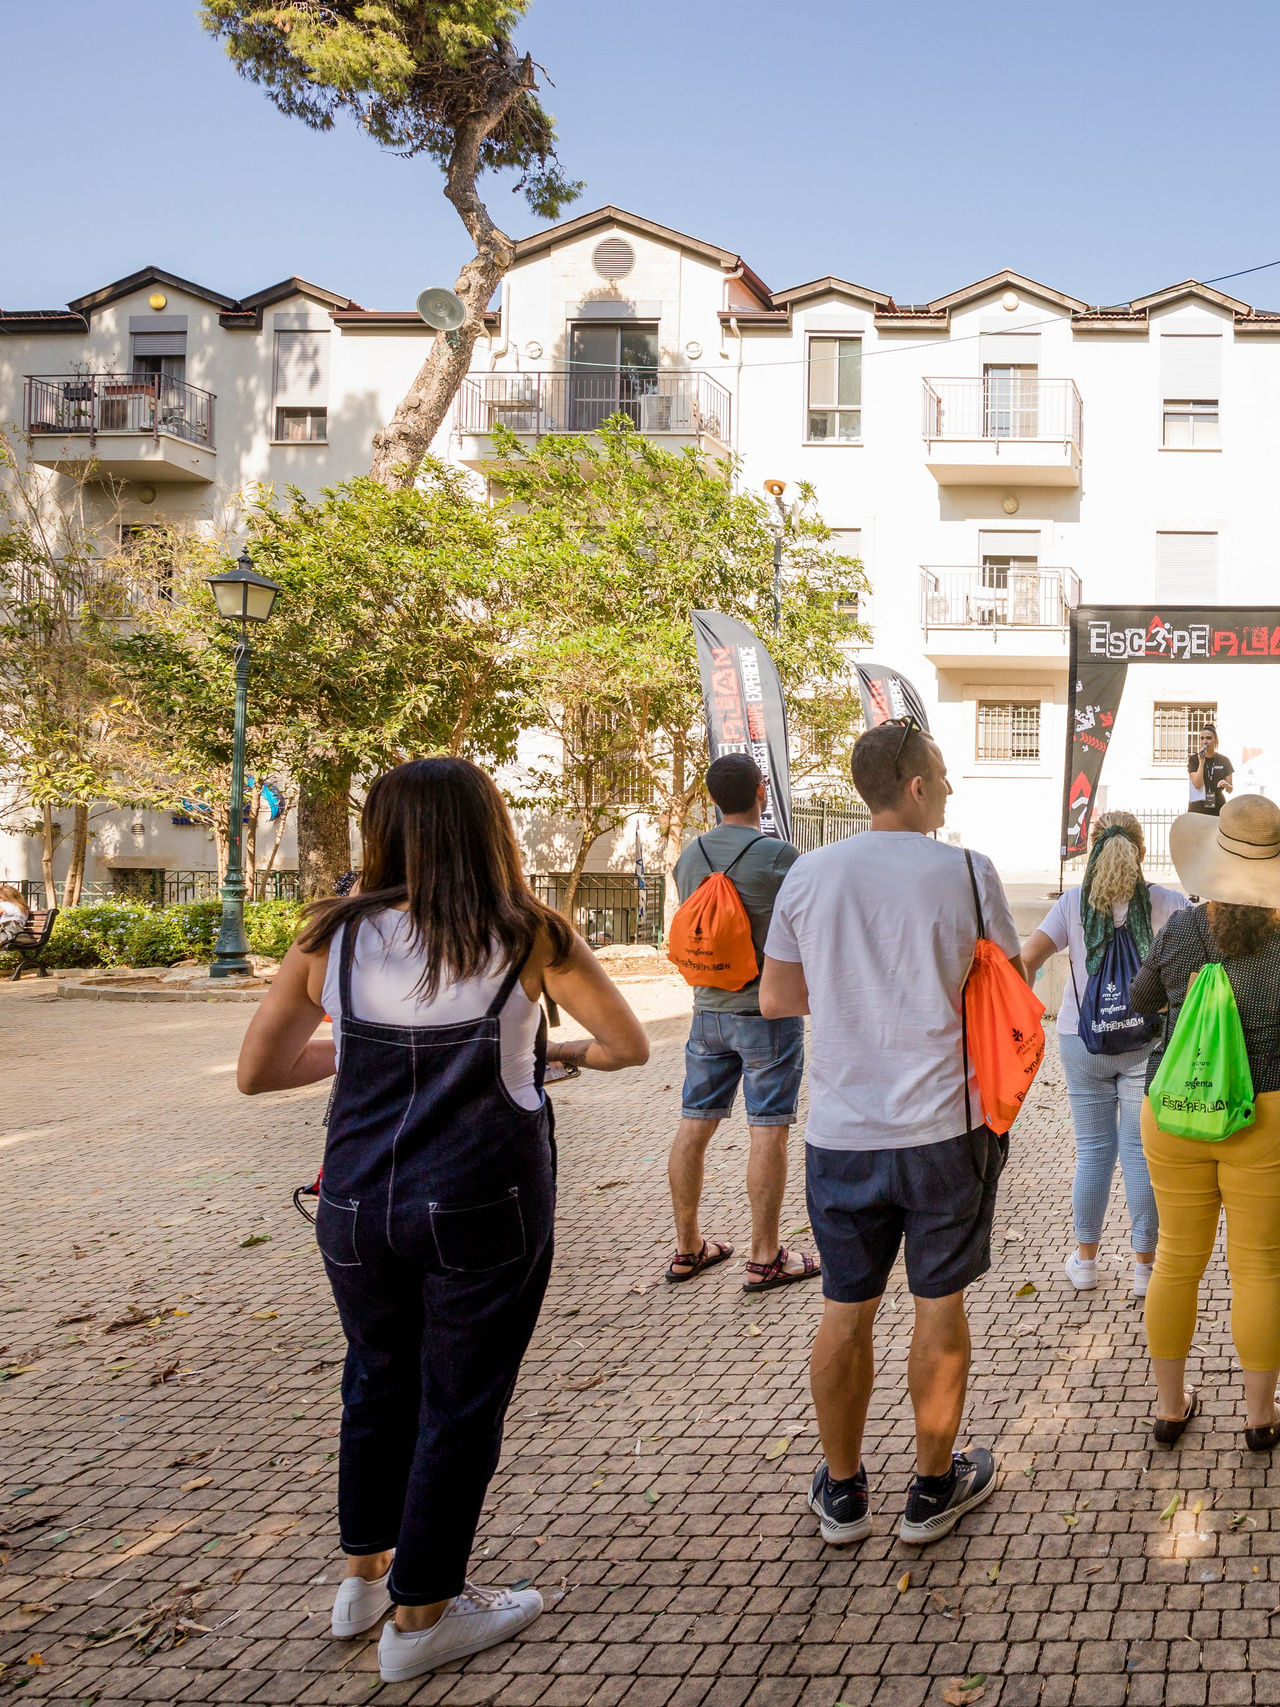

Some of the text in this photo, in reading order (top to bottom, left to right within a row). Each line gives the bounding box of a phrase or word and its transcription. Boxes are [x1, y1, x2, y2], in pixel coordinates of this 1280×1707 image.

[740, 646, 763, 701] EXPERIENCE
[746, 703, 767, 740] ESCAPE
[753, 742, 769, 777] IGGEST
